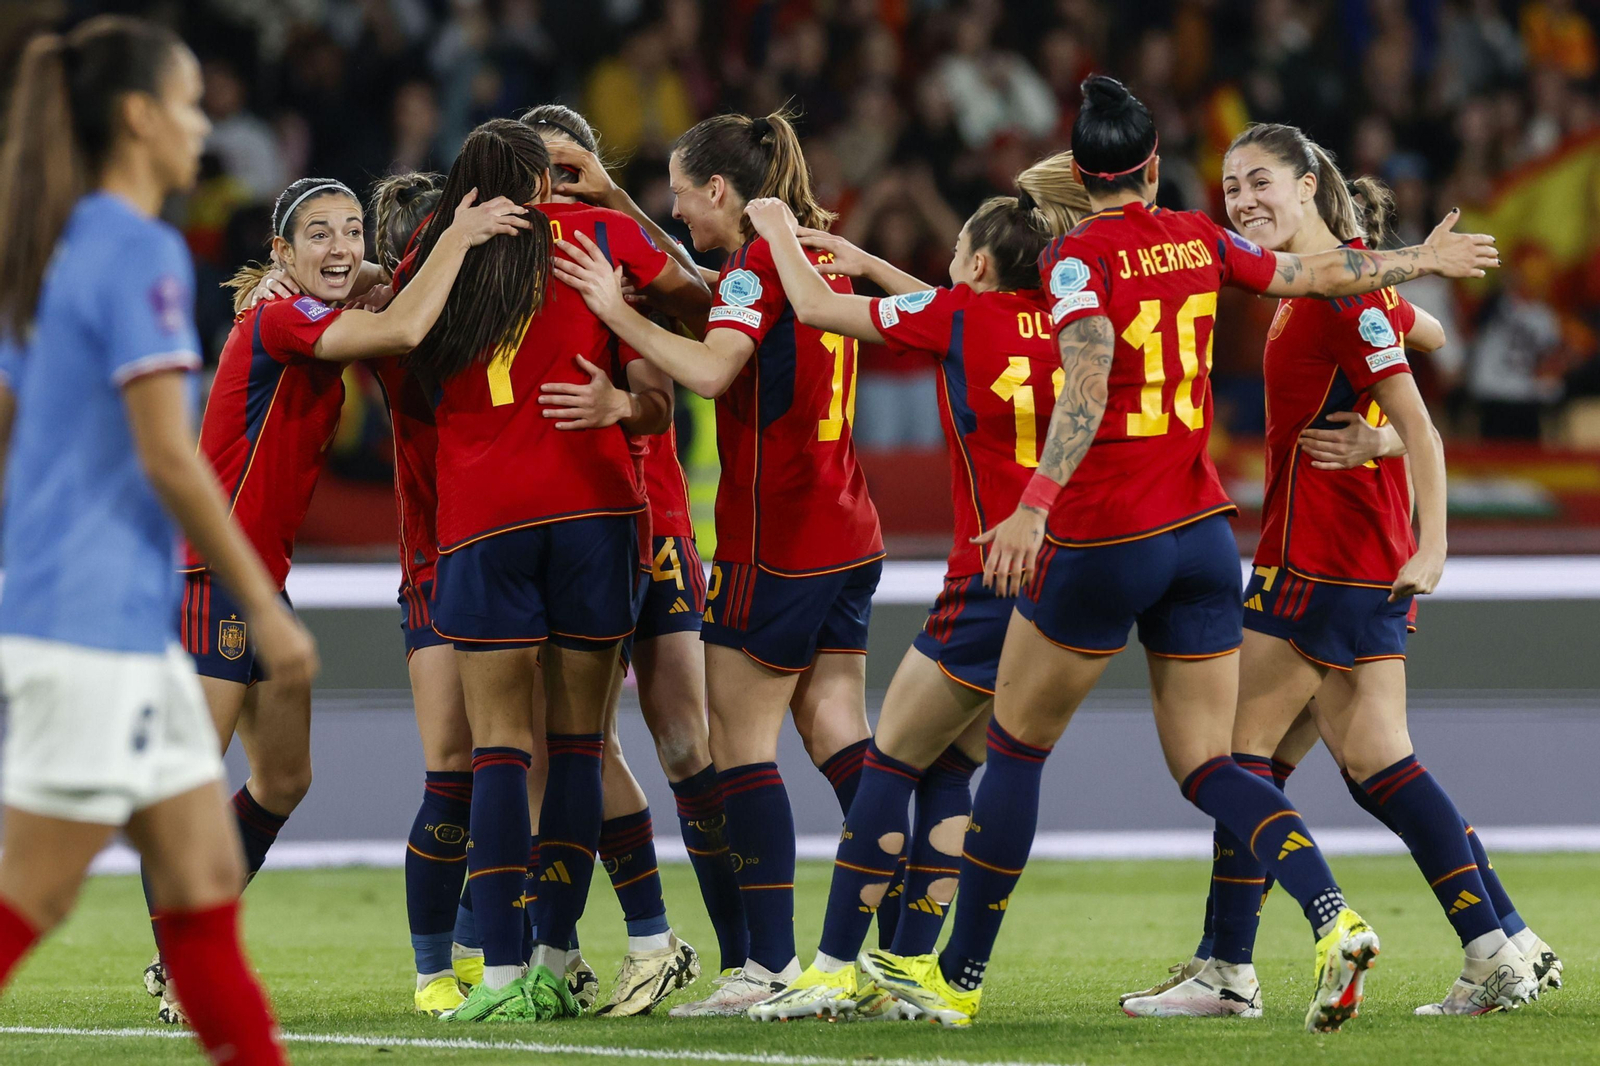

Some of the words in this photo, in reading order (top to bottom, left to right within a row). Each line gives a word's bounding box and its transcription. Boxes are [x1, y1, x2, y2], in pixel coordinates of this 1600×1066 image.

[1117, 249, 1139, 280] J.
[710, 309, 760, 323] FOUNDATION
[1121, 291, 1217, 436] 10
[652, 536, 685, 591] 4
